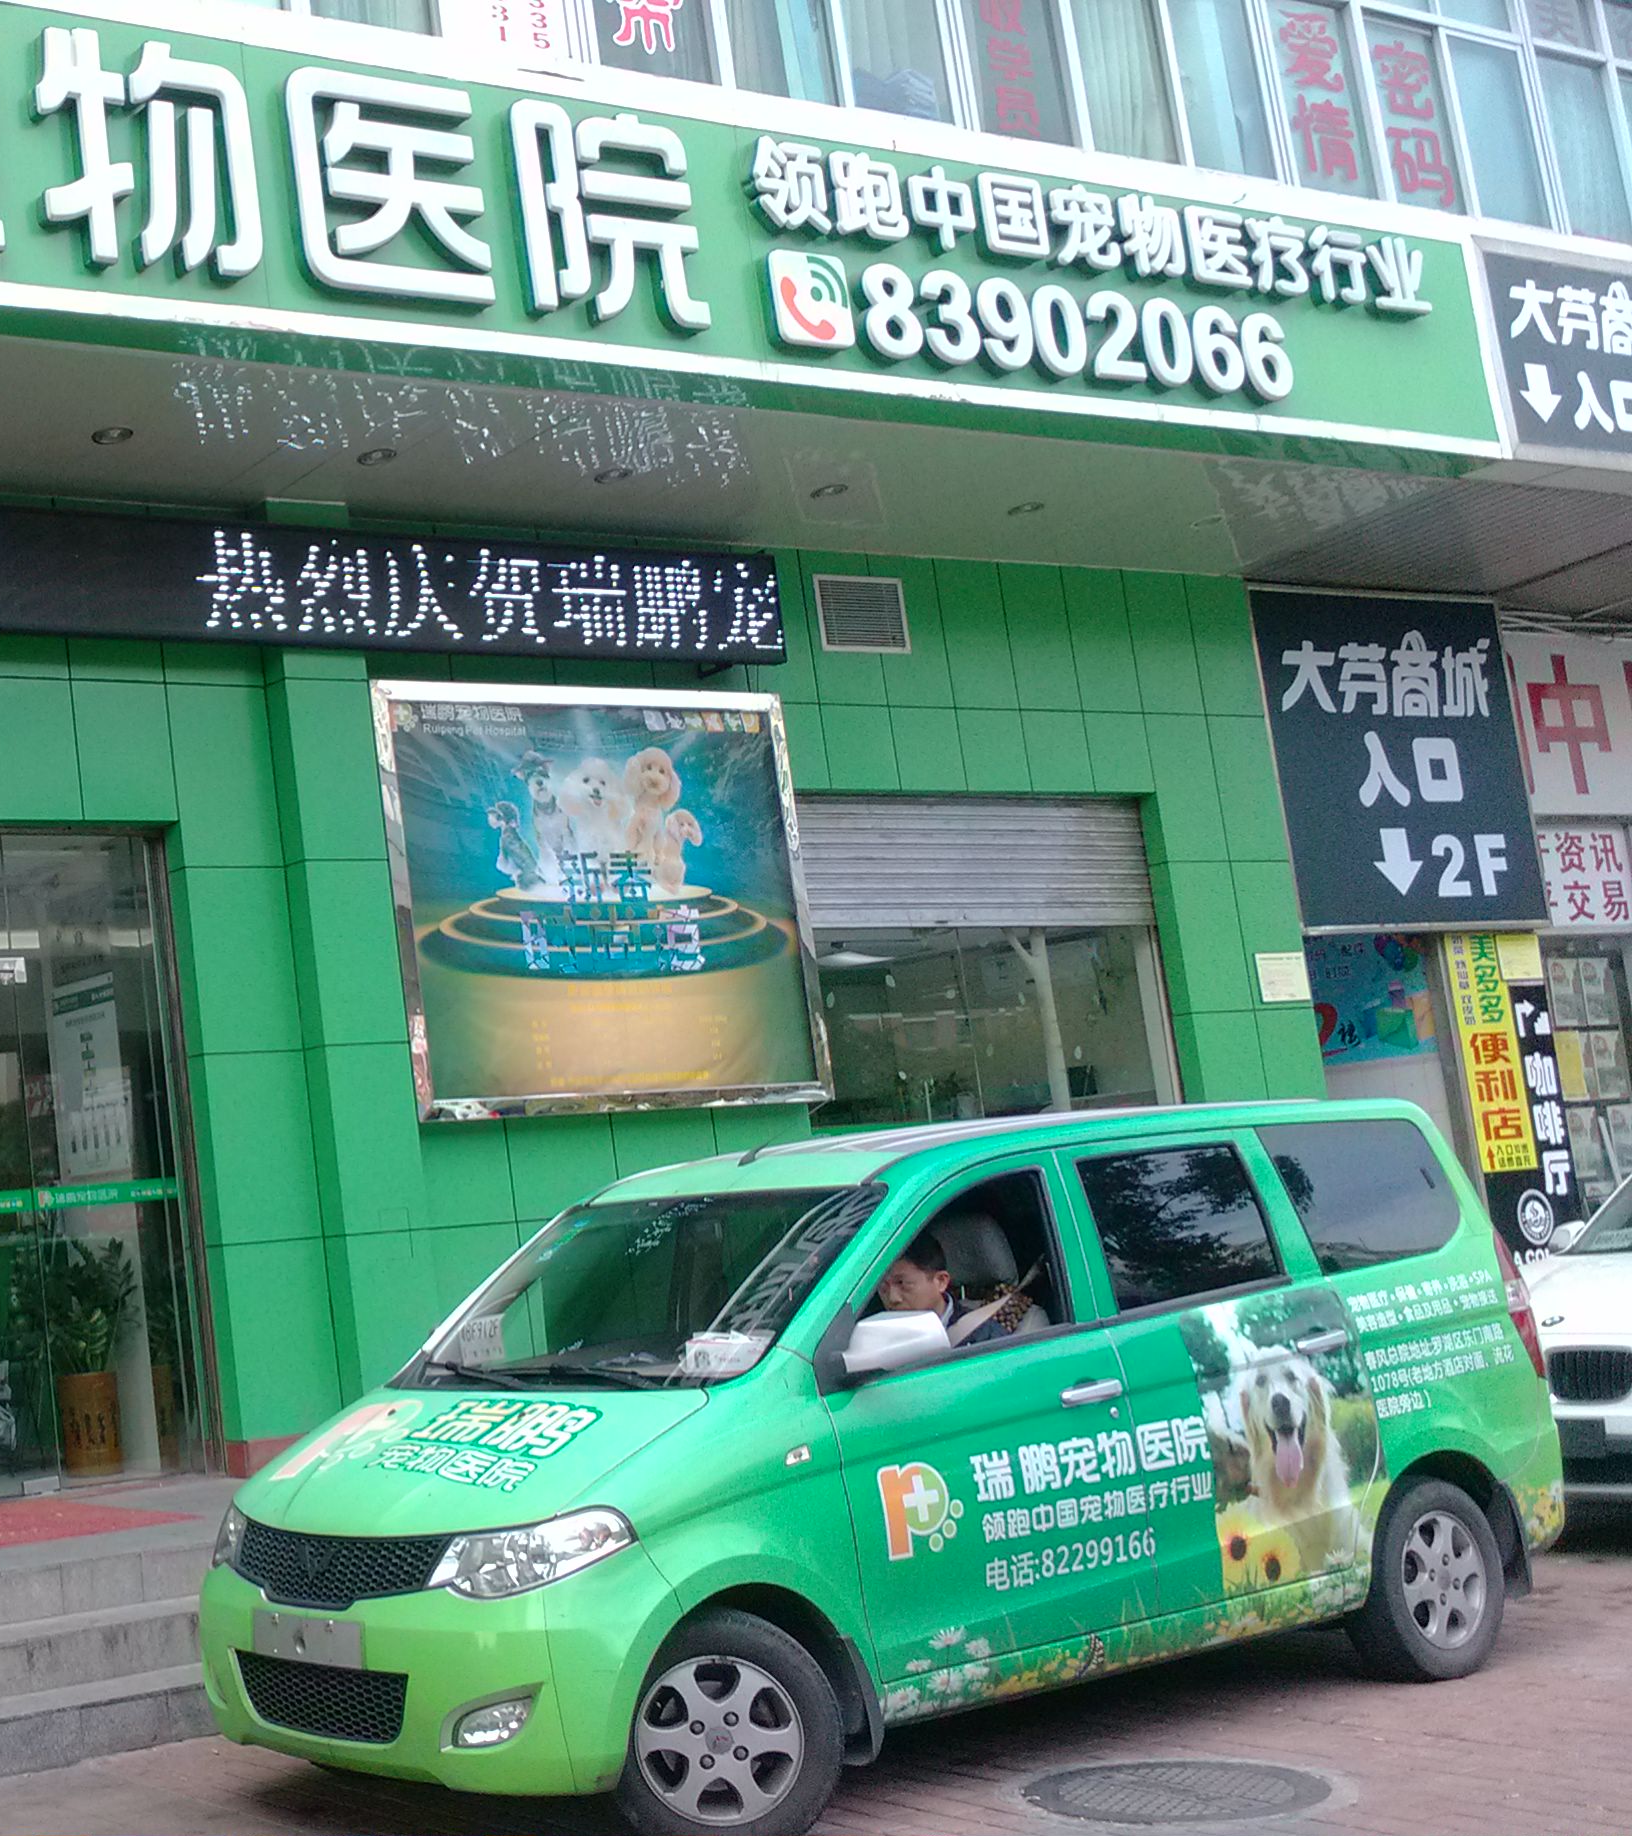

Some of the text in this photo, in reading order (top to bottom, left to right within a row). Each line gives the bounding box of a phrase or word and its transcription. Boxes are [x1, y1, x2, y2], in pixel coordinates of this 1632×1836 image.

[1278, 9, 1359, 182] 爱情
[1373, 40, 1457, 208] 密码
[751, 133, 1433, 318] 领跑中国宠物医疗行业
[861, 255, 1295, 402] 83902066
[1358, 731, 1464, 808] 入口
[1430, 834, 1508, 897] 2F
[1469, 1031, 1524, 1142] 便利店
[1524, 1051, 1572, 1196] 咖啡厅
[366, 1442, 538, 1492] 宠物医院
[408, 1399, 601, 1458] 瑞鹏
[970, 1415, 1211, 1503] 瑞鹏宠物医院
[982, 1471, 1213, 1544] 领跑中国宠物医疗行业
[985, 1527, 1156, 1592] 电话:82299166
